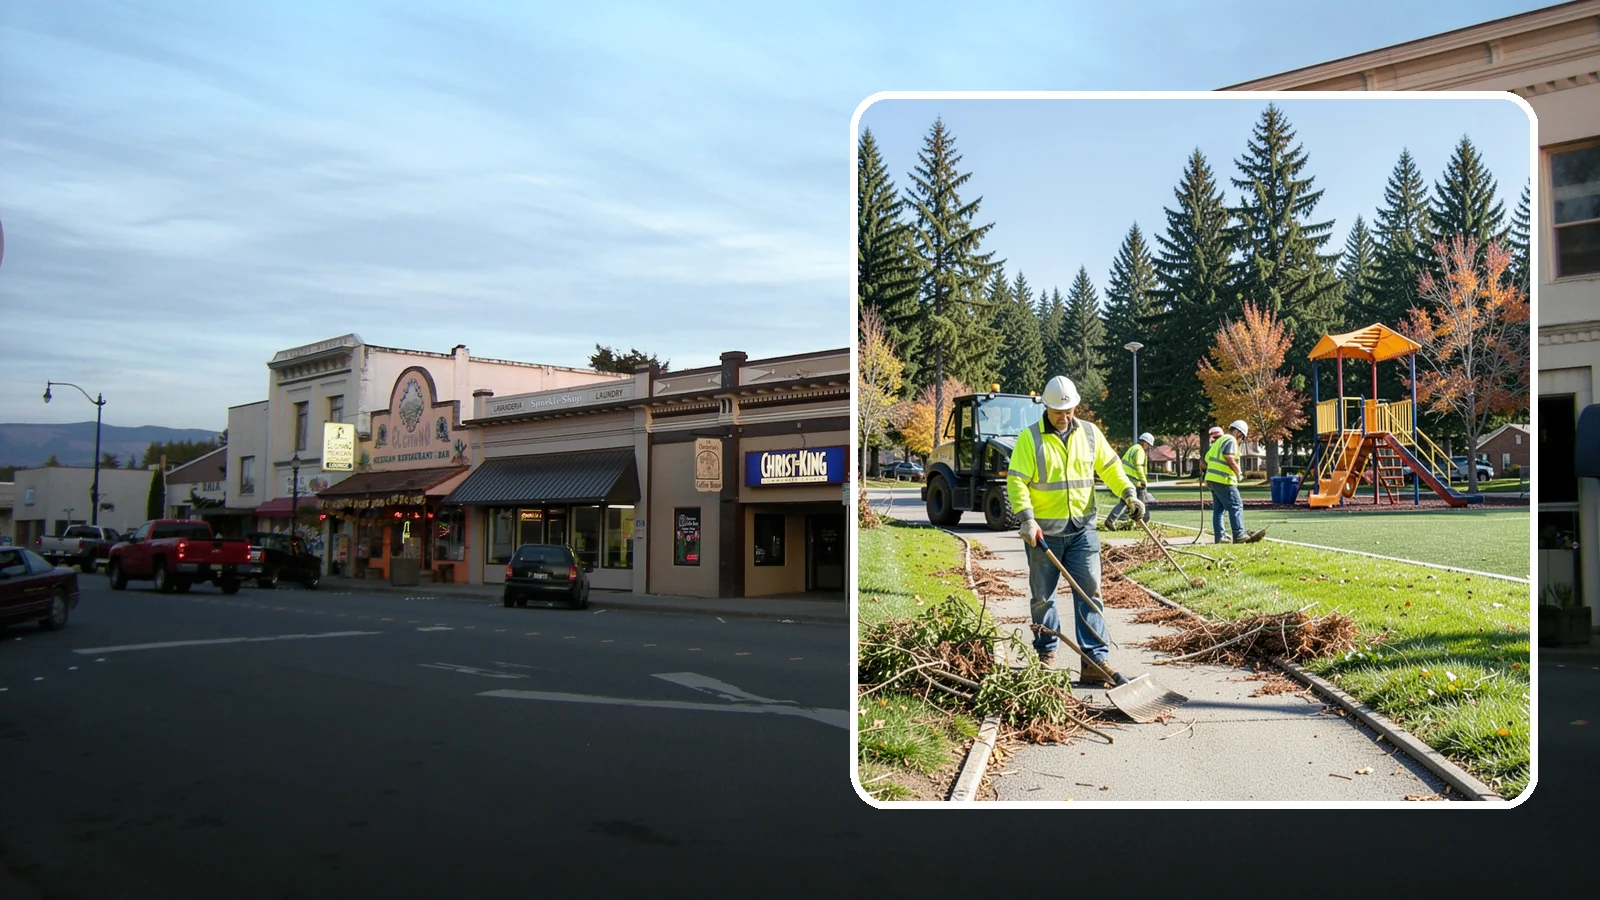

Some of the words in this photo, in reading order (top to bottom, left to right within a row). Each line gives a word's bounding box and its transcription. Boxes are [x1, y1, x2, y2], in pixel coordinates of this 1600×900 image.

[562, 394, 583, 404] Shop
[595, 389, 624, 400] LAUNDRY
[493, 402, 523, 412] LAVANDERIA
[374, 455, 396, 464] MEXICAN
[397, 451, 433, 462] RESTAURANT
[438, 450, 450, 459] BAR
[761, 452, 798, 478] CHRIST
[799, 450, 827, 476] KING
